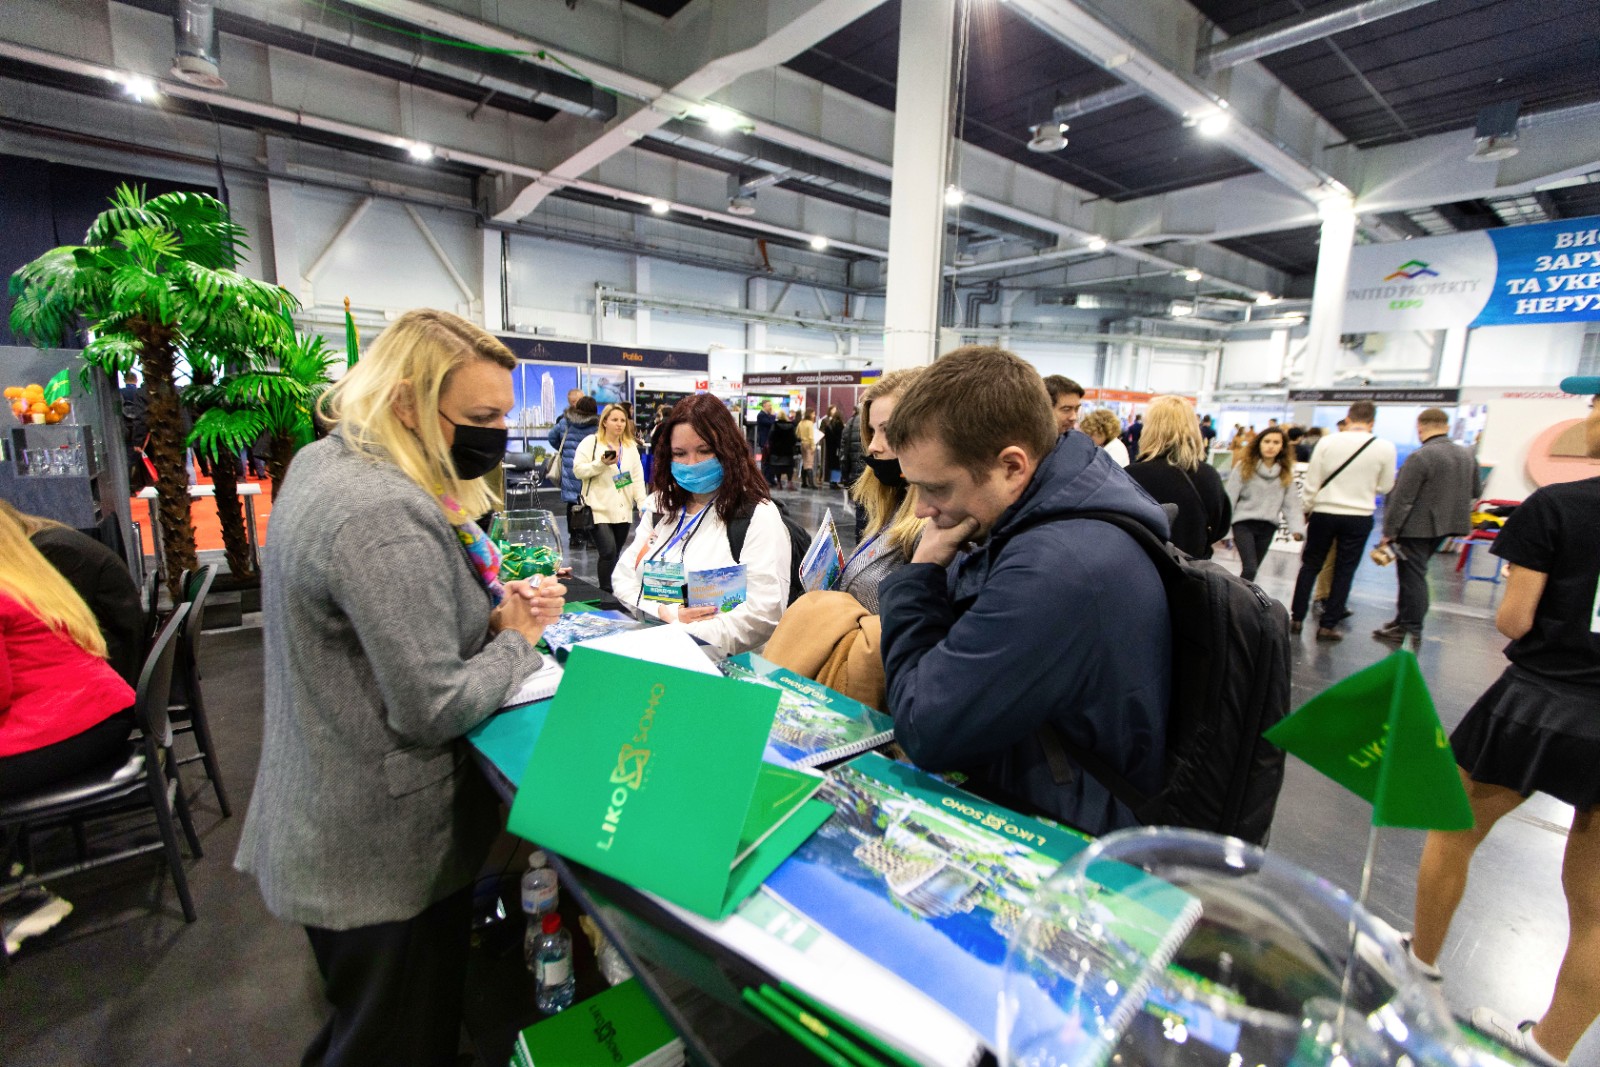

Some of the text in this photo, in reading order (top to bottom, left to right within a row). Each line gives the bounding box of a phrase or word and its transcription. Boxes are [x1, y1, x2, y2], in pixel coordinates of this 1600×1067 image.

[1553, 229, 1600, 249] ВИ
[1346, 286, 1396, 300] NITED
[1506, 272, 1600, 295] ТА УКР
[597, 786, 628, 851] LIKO
[633, 682, 666, 744] SOHO
[941, 797, 985, 820] SOHO
[1004, 823, 1047, 847] LIKO
